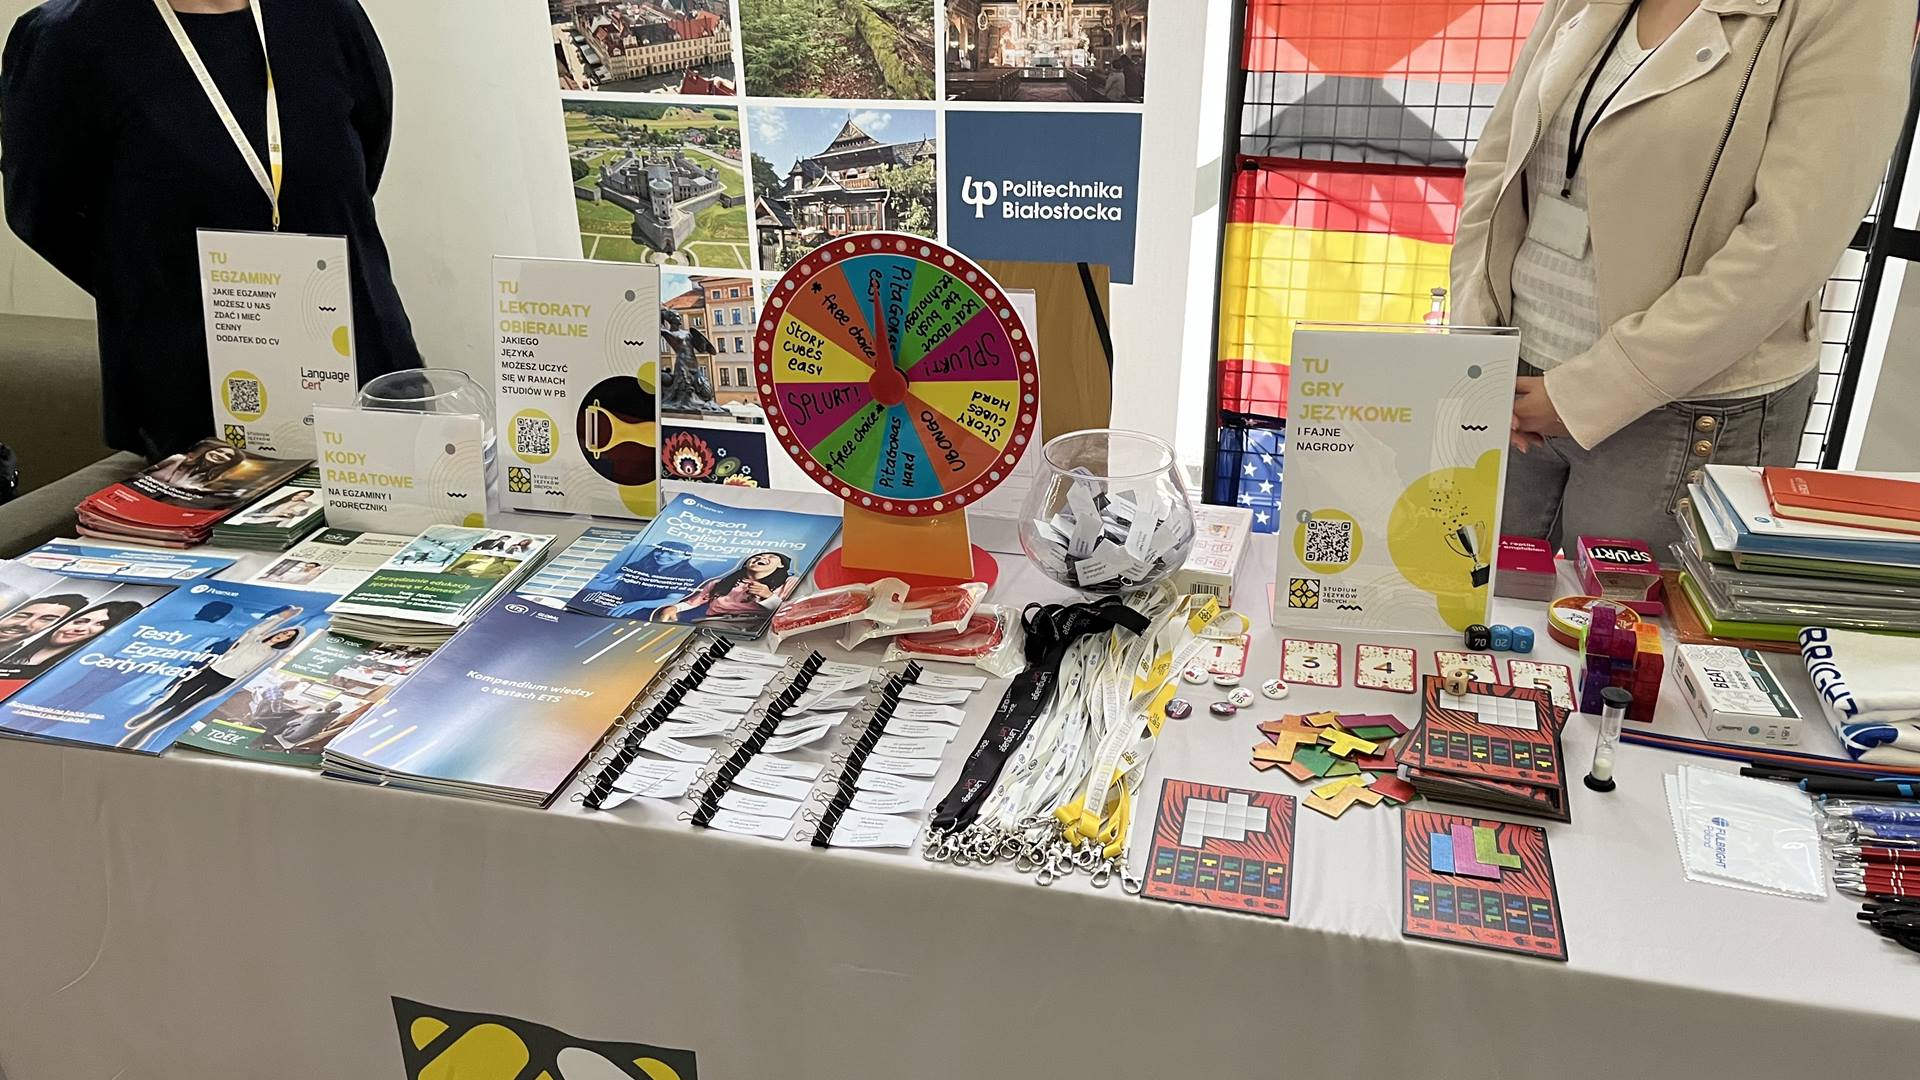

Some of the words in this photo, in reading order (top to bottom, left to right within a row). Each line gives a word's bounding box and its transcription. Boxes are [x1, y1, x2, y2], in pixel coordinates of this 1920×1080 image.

[1003, 180, 1123, 198] Politechnika
[1003, 202, 1122, 221] Białostocka
[209, 251, 227, 264] TU
[210, 270, 281, 285] EGZAMINY
[212, 288, 234, 296] JAKIE
[237, 289, 276, 298] EGZAMINY
[498, 281, 519, 294] TU
[213, 300, 244, 309] MOŻESZ
[941, 290, 962, 310] the
[214, 311, 235, 320] ZDAĆ
[242, 312, 261, 321] MIEĆ
[499, 300, 591, 317] LEKTORATY
[215, 323, 242, 331] CENNY
[500, 320, 588, 337] OBIERALNE
[916, 309, 943, 338] bush
[216, 335, 254, 344] DODATEK
[269, 338, 280, 346] CV
[501, 336, 539, 346] JAKIEGO
[921, 322, 952, 353] about
[501, 349, 535, 358] JĘZYKA
[924, 332, 1000, 376] SPLURT!
[502, 361, 536, 371] MOŻESZ
[539, 364, 568, 373] UCZYĆ
[1302, 358, 1329, 374] TU
[300, 367, 350, 383] Language
[502, 374, 515, 383] SIĘ
[527, 376, 566, 385] RAMACH
[301, 379, 322, 391] Cert
[502, 386, 542, 396] STUDIÓW
[554, 390, 566, 398] PB
[1301, 381, 1344, 398] GRY
[787, 386, 861, 426] SPLURT!
[1299, 404, 1412, 424] JĘZYKOWE
[323, 431, 343, 445] TU
[1304, 428, 1341, 437] FAJNE
[921, 410, 966, 472] UBONGO
[1297, 442, 1354, 452] NAGRODY
[324, 451, 366, 466] KODY
[327, 469, 414, 489] RABATOWE
[328, 488, 341, 496] NA
[342, 489, 387, 500] EGZAMINY
[330, 500, 387, 512] PODRĘCZNIKI
[666, 516, 763, 538] Connected
[680, 510, 747, 529] Pearson
[666, 526, 727, 544] English
[731, 537, 807, 551] Learning
[693, 541, 771, 554] Program
[132, 625, 192, 645] Testy
[1474, 637, 1487, 648] 70
[121, 641, 232, 665] Egzaminy
[79, 652, 203, 681] Certyfikaty
[1302, 655, 1321, 669] 3
[1373, 661, 1396, 675] 4
[466, 670, 548, 691] Kompendium
[550, 686, 594, 698] wiedzy
[1703, 667, 1730, 689] BEAT
[492, 687, 537, 700] testach
[537, 694, 563, 703] ETS
[1265, 684, 1278, 696] PB
[1231, 693, 1245, 704] PB
[1715, 828, 1727, 869] FULBRIGHT
